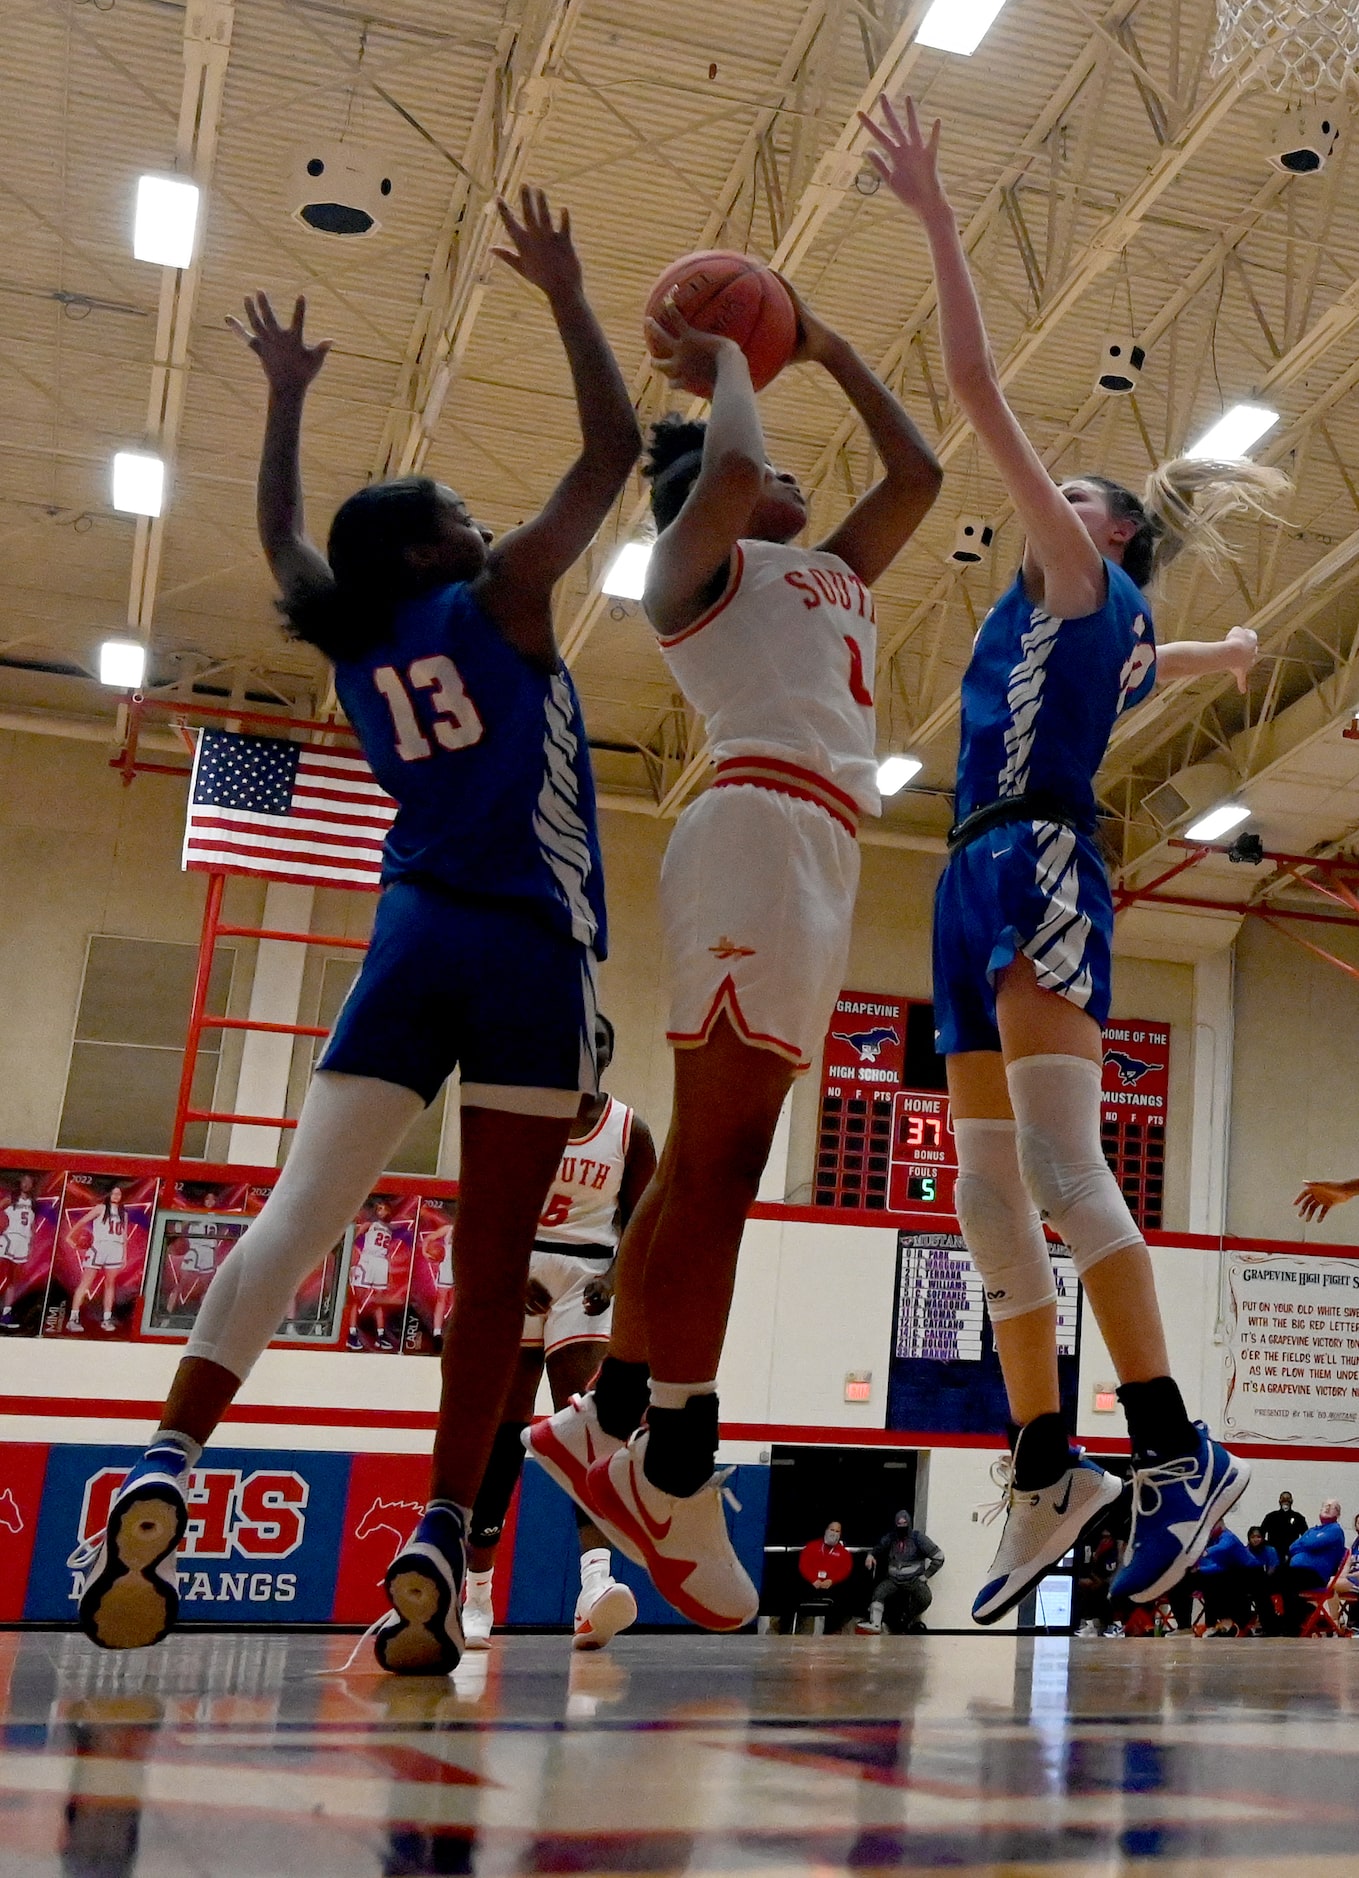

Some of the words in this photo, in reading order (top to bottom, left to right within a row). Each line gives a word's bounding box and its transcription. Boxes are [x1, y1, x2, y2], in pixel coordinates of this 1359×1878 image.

[373, 654, 485, 762] 13
[837, 1000, 900, 1018] GRAPEVINE
[1102, 1028, 1130, 1042] HOME
[1133, 1032, 1146, 1042] OF
[1149, 1033, 1167, 1045] THE
[829, 1065, 855, 1080] HIGH
[858, 1067, 900, 1083] SCHOOL
[828, 1087, 841, 1097] NO
[855, 1090, 862, 1099] F
[874, 1091, 891, 1101] PTS
[1101, 1091, 1163, 1107] MUSTANGS
[904, 1099, 940, 1114] HOME
[1105, 1111, 1118, 1121] NO
[1131, 1113, 1137, 1123] F
[1148, 1115, 1164, 1125] PTS
[907, 1117, 941, 1146] 37
[914, 1149, 945, 1161] BONUS
[561, 1157, 611, 1190] UTH
[909, 1166, 938, 1177] FOULS
[70, 1175, 93, 1185] 2022
[921, 1179, 935, 1201] 5
[422, 1199, 444, 1209] 2022
[20, 1212, 29, 1226] 5
[108, 1220, 124, 1236] 10
[374, 1232, 392, 1249] 22
[928, 1280, 967, 1290] WILLIAMS
[1243, 1269, 1297, 1282] GRAPEVINE
[1299, 1272, 1320, 1286] HIGH
[1322, 1274, 1350, 1287] FIGHT
[902, 1298, 911, 1307] 10
[1242, 1301, 1257, 1311] PUT
[1259, 1302, 1270, 1312] ON
[1273, 1303, 1294, 1314] YOUR
[1297, 1304, 1313, 1315] OLD
[1317, 1305, 1341, 1317] WHITE
[922, 1308, 956, 1319] THOMAS
[900, 1318, 909, 1328] 12
[1248, 1316, 1268, 1327] WITH
[1272, 1318, 1287, 1328] THE
[1291, 1319, 1305, 1330] BIG
[1309, 1320, 1325, 1330] RED
[406, 1315, 420, 1350] CARLY
[1241, 1331, 1257, 1344] IT'S
[1260, 1334, 1266, 1344] A
[1268, 1334, 1309, 1347] GRAPEVINE
[1312, 1337, 1343, 1348] VICTORY
[1241, 1348, 1260, 1361] O'ER
[1264, 1351, 1279, 1361] THE
[1282, 1352, 1311, 1364] FIELDS
[1314, 1353, 1337, 1365] WE'LL
[1249, 1366, 1261, 1376] AS
[1265, 1367, 1277, 1376] WE
[1281, 1367, 1304, 1378] PLOW
[1310, 1368, 1332, 1379] THEM
[1242, 1380, 1258, 1393] IT'S
[1260, 1383, 1266, 1393] A
[1267, 1383, 1311, 1395] GRAPEVINE
[1315, 1386, 1347, 1397] VICTORY
[1254, 1408, 1289, 1417] PRESENTED
[1292, 1410, 1300, 1418] BY
